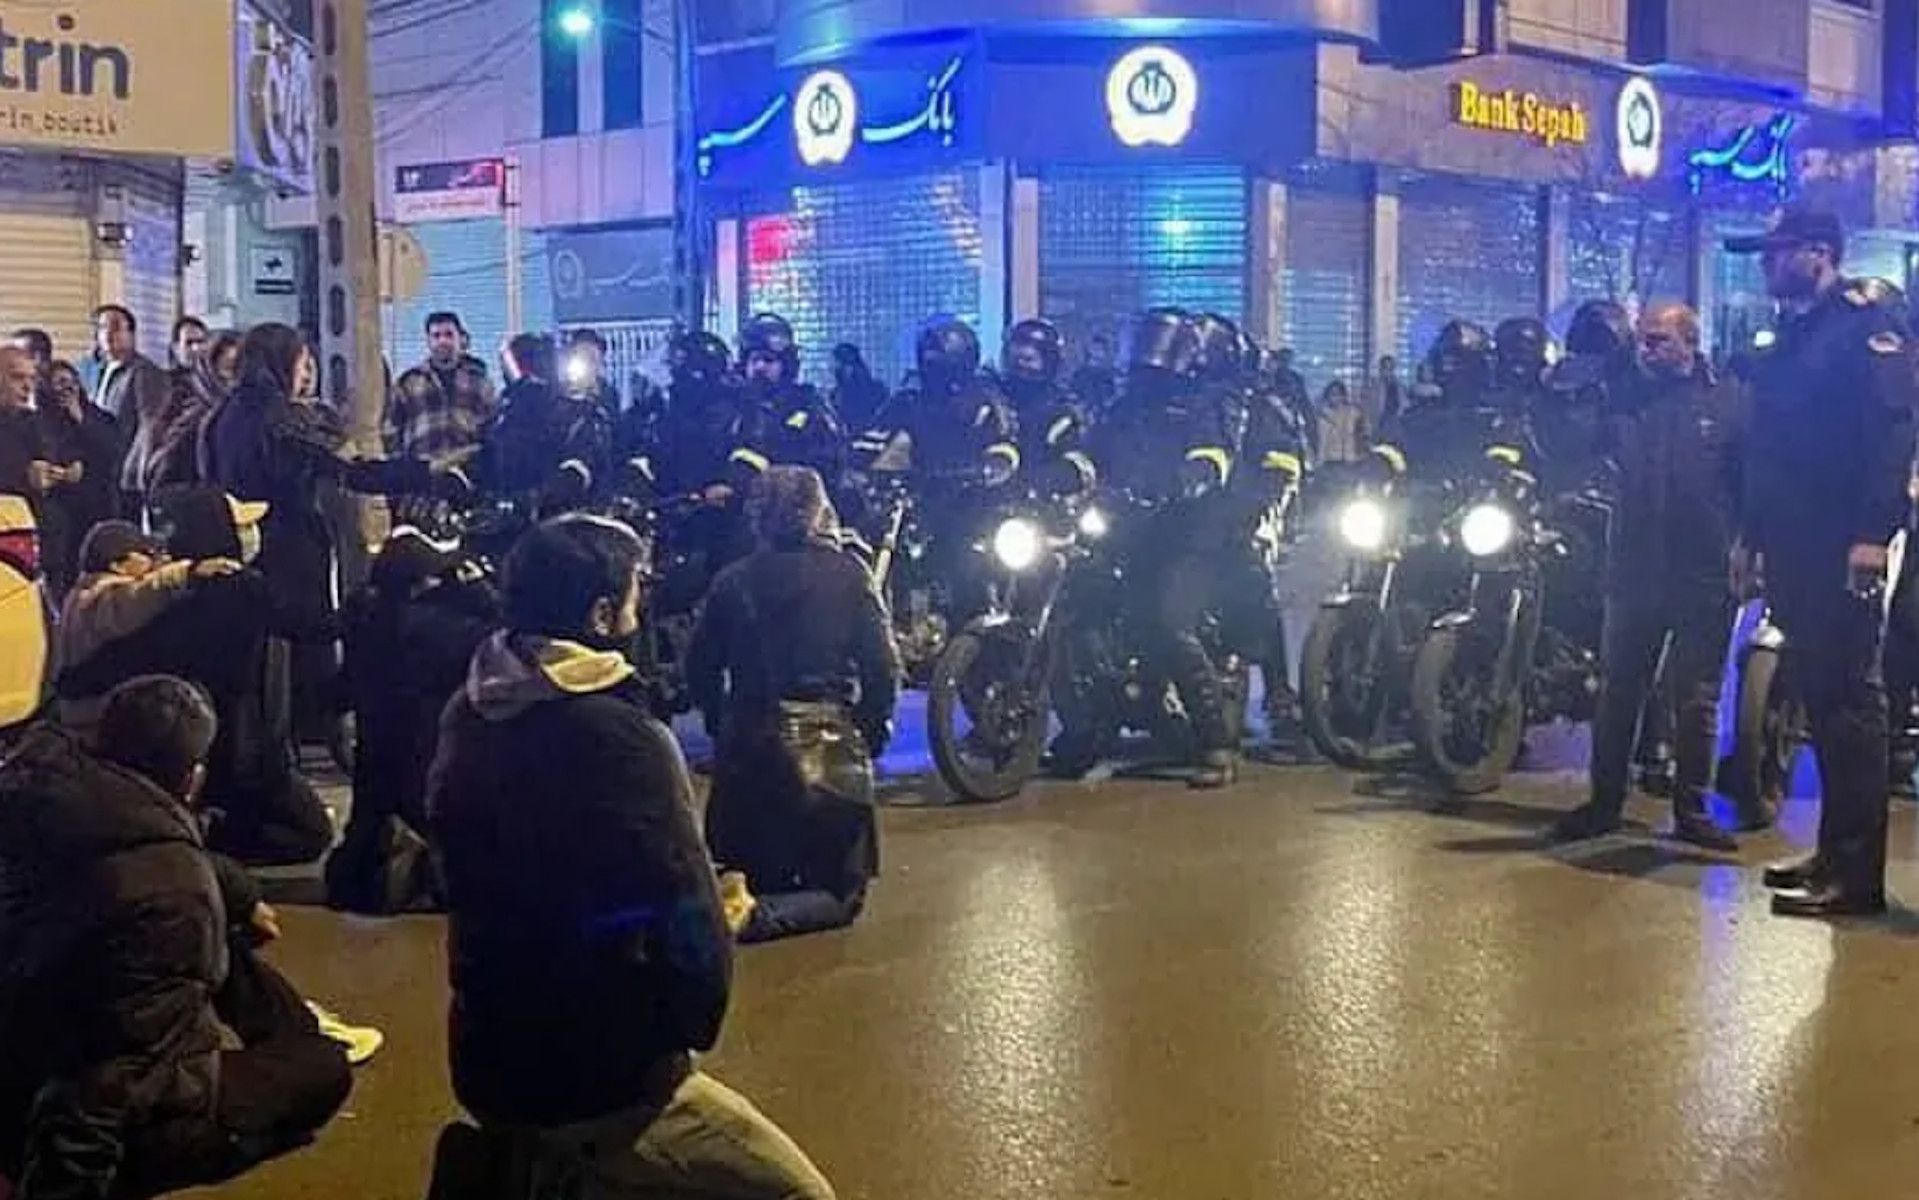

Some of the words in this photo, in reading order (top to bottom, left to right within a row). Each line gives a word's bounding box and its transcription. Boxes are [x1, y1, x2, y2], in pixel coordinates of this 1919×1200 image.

[861, 56, 961, 148] بانک
[1460, 81, 1520, 131] Bank
[1522, 91, 1586, 148] Sepah
[1731, 112, 1793, 199] بانک
